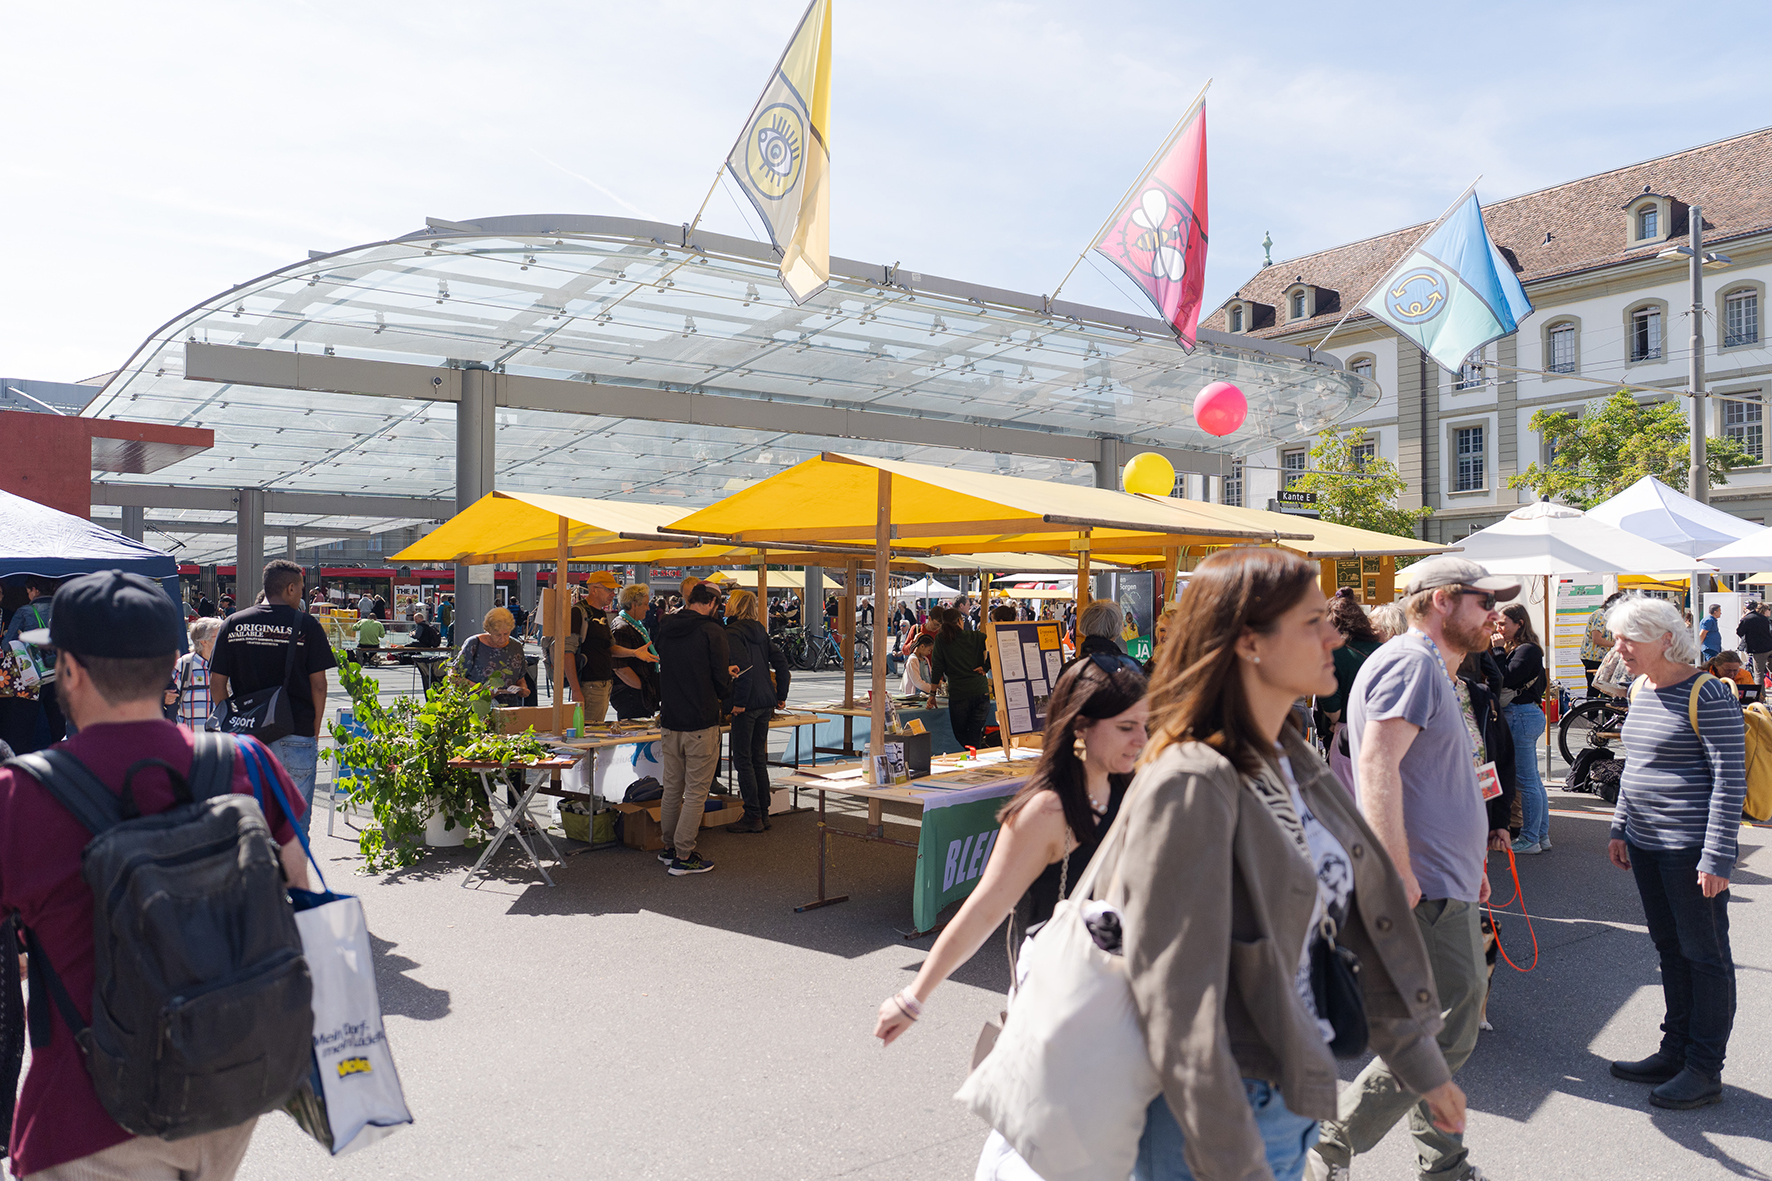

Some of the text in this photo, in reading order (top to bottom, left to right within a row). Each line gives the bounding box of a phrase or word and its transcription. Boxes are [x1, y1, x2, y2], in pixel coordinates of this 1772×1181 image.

[1282, 492, 1310, 501] Kante E
[228, 631, 264, 639] AVAILABLE
[235, 623, 293, 635] ORIGINALS
[1135, 643, 1151, 658] JA
[229, 715, 256, 728] sport
